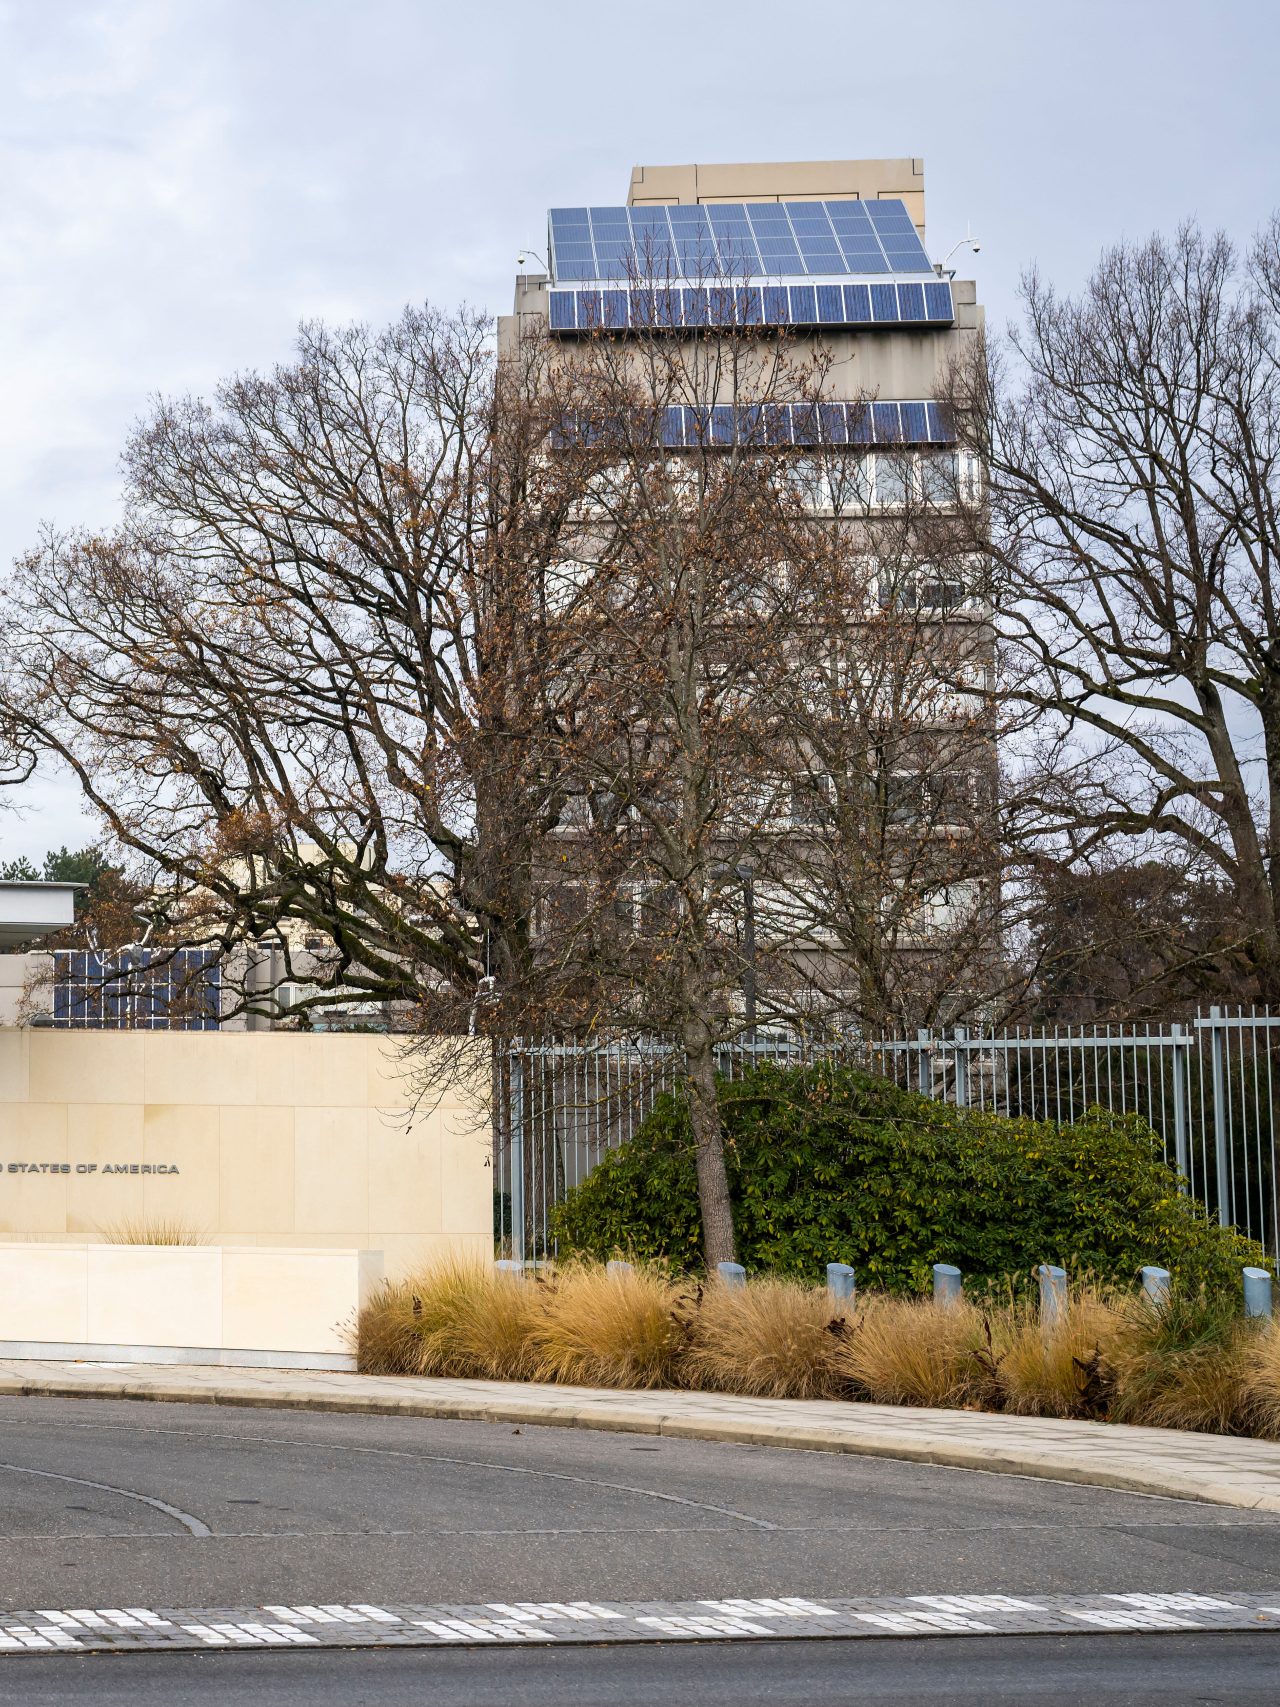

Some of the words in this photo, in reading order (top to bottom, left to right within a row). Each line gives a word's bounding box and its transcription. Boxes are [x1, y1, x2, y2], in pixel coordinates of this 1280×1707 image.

[7, 1163, 71, 1174] STATES
[76, 1163, 97, 1174] OF
[102, 1163, 180, 1175] AMERICA
